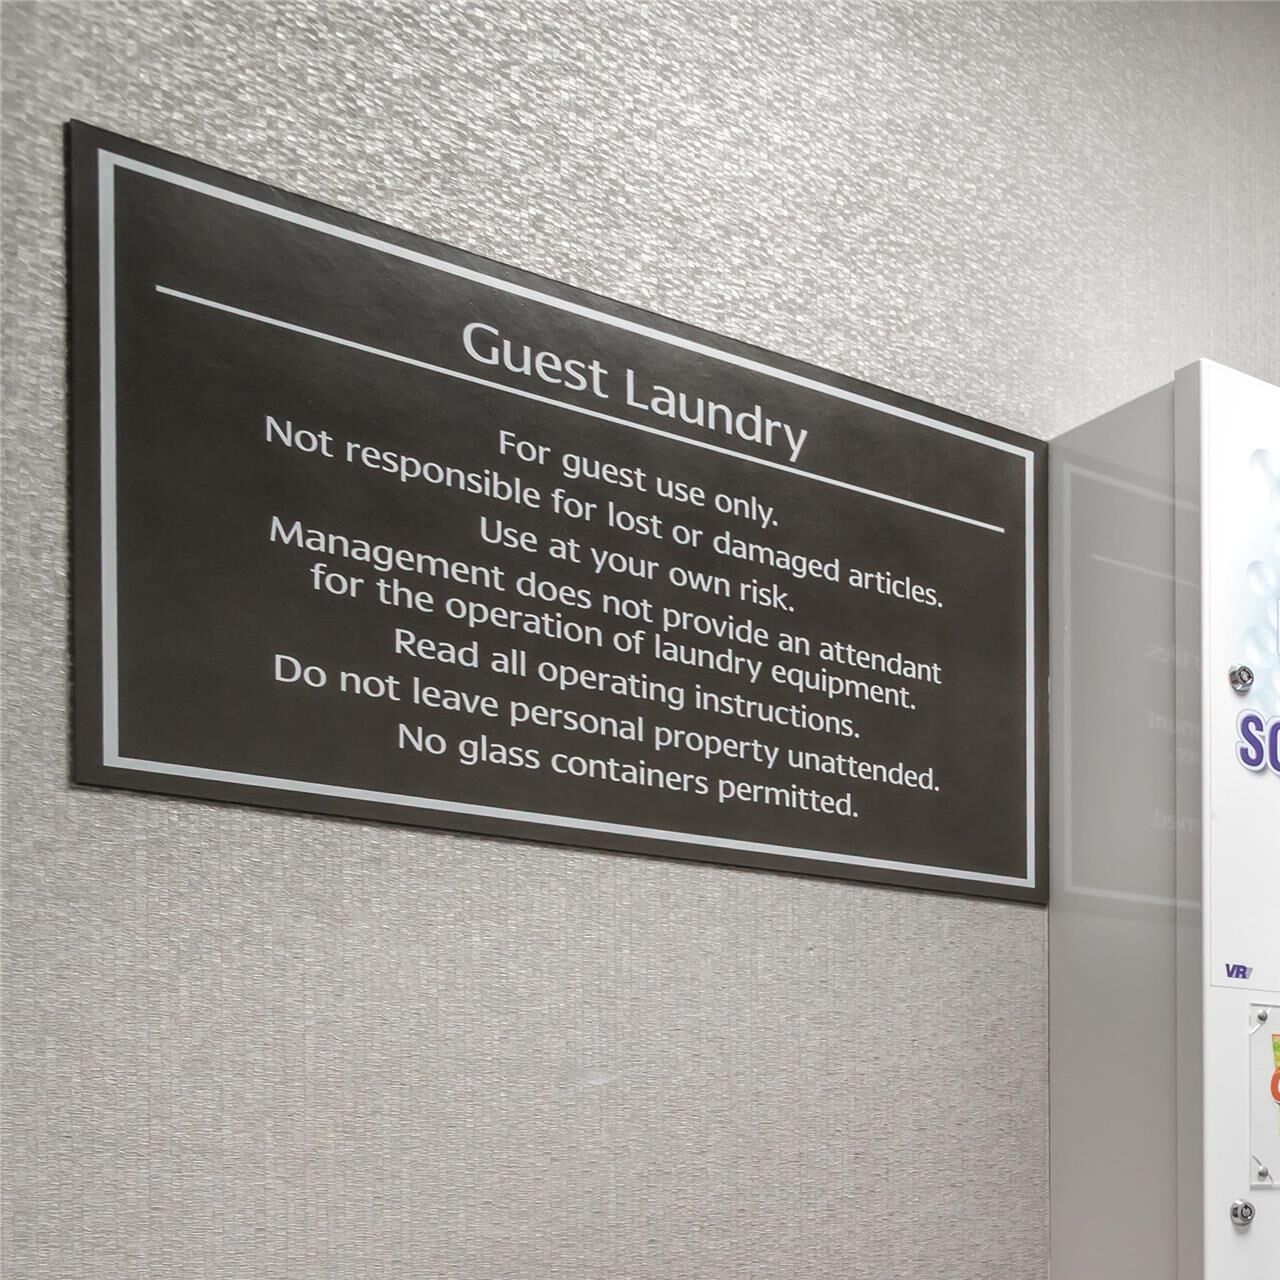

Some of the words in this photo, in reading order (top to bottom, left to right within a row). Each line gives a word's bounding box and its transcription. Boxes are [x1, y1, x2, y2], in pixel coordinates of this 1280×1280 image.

[462, 322, 609, 399] Guest
[625, 368, 809, 463] Laundry
[266, 415, 334, 458] Not
[346, 441, 541, 509] responsible
[550, 487, 598, 522] for
[608, 500, 664, 539] lost
[671, 524, 704, 548] or
[712, 530, 840, 583] damaged
[848, 568, 943, 608] articles.
[499, 429, 552, 465] For
[561, 453, 648, 492] guest
[656, 476, 706, 507] use
[714, 493, 779, 529] only.
[269, 515, 506, 592] Management
[515, 570, 592, 610] does
[602, 594, 654, 623] not
[663, 607, 769, 647] provide
[777, 632, 810, 657] an
[819, 641, 943, 685] attendant
[480, 516, 538, 553] Use
[548, 538, 581, 564] at
[590, 547, 660, 580] your
[668, 566, 731, 598] own
[740, 578, 795, 613] risk.
[309, 562, 365, 598] for
[375, 578, 434, 613] the
[445, 597, 603, 648] operation
[612, 629, 647, 655] of
[654, 632, 763, 684] laundry
[771, 664, 916, 710] equipment.
[395, 628, 479, 669] Read
[490, 648, 527, 677] all
[537, 661, 685, 711] operating
[695, 683, 860, 739] instructions.
[274, 653, 327, 688] Do
[340, 671, 401, 701] not
[413, 676, 499, 718] leave
[510, 700, 644, 742] personal
[654, 725, 780, 770] property
[787, 749, 940, 792] unattended.
[398, 723, 447, 755] No
[458, 734, 541, 770] glass
[550, 753, 709, 795] containers
[718, 778, 859, 818] permitted.
